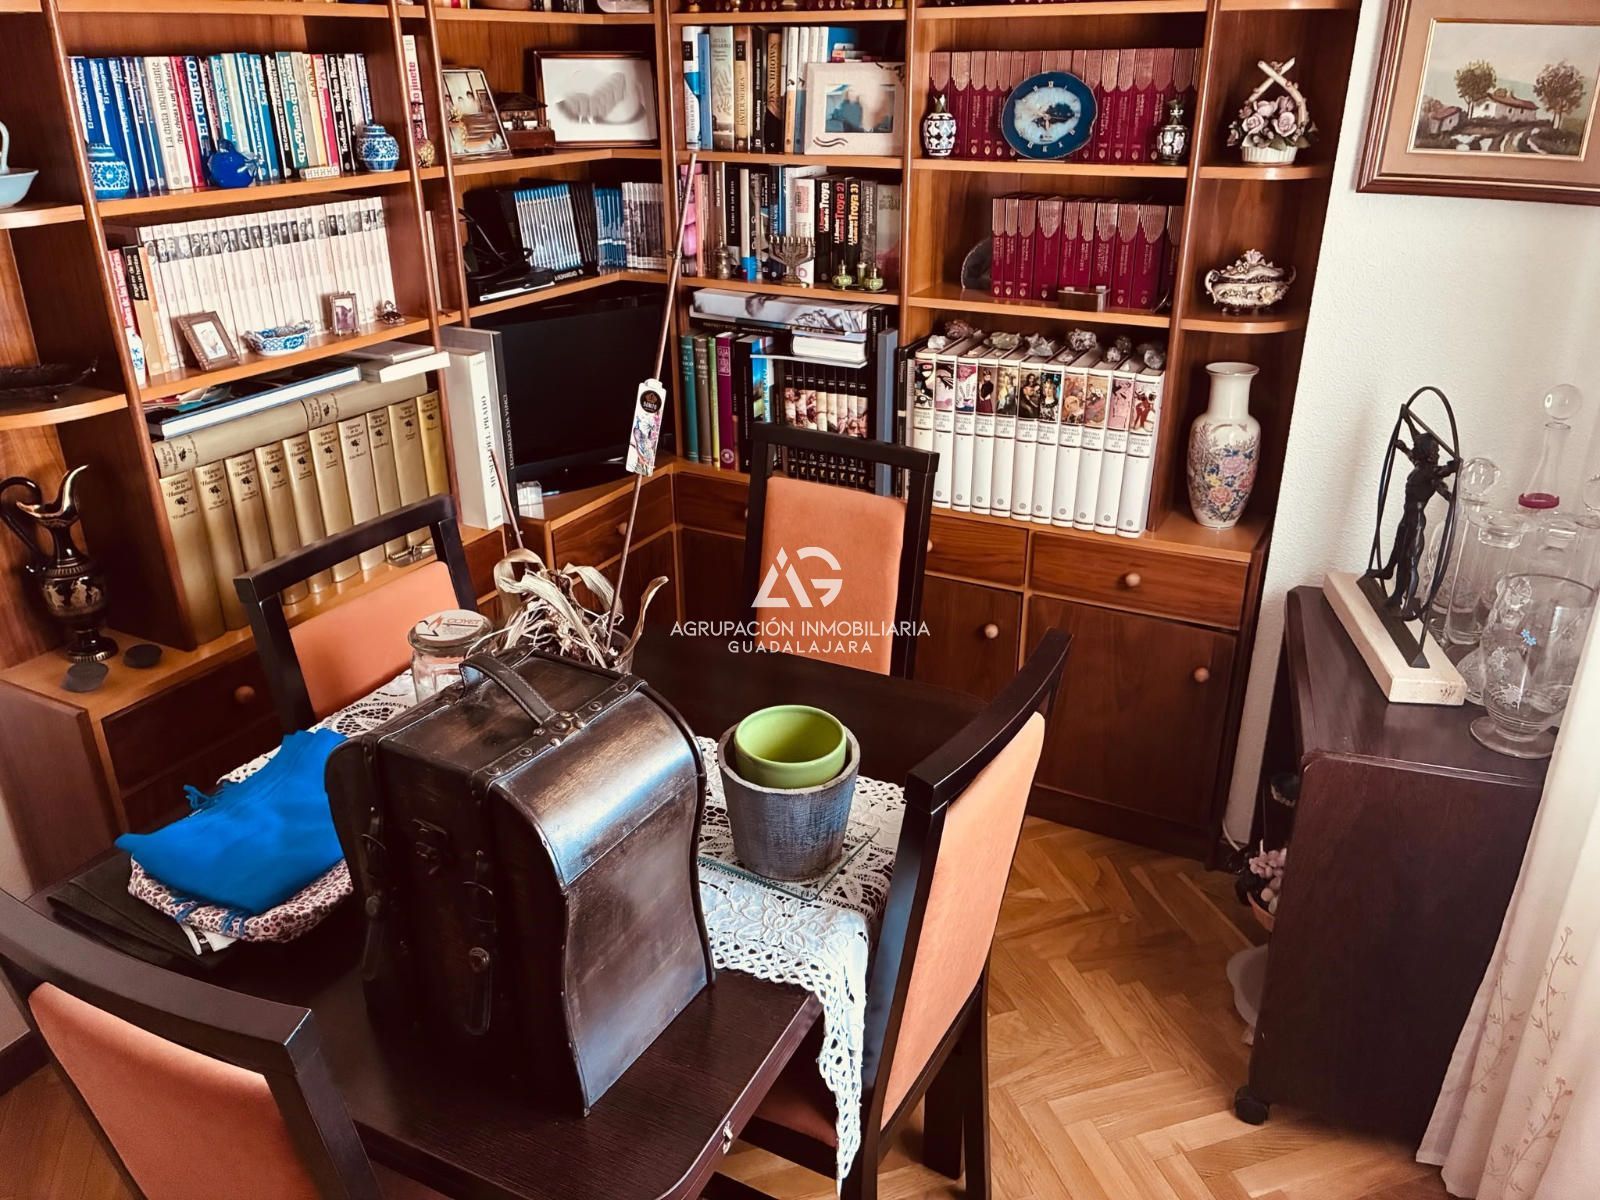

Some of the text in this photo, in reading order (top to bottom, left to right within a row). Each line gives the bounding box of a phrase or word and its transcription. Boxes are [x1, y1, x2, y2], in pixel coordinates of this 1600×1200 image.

[98, 62, 108, 96] peregrino
[283, 55, 295, 82] pasa
[327, 56, 337, 78] Royo
[408, 60, 418, 91] jinete
[767, 42, 776, 103] DAN BROWN
[76, 61, 93, 129] El comedido hidalgo
[187, 58, 205, 116] GRIEGO
[287, 83, 298, 105] que
[331, 78, 341, 113] Rodrigo
[151, 60, 173, 149] La duda inquietante
[197, 117, 208, 137] EL
[819, 182, 830, 208] Troya
[836, 182, 844, 191] 2)
[850, 183, 858, 193] 3)
[834, 193, 845, 218] Troya
[848, 194, 859, 220] Troya
[504, 417, 510, 428] DA
[506, 428, 515, 470] LEONARDO
